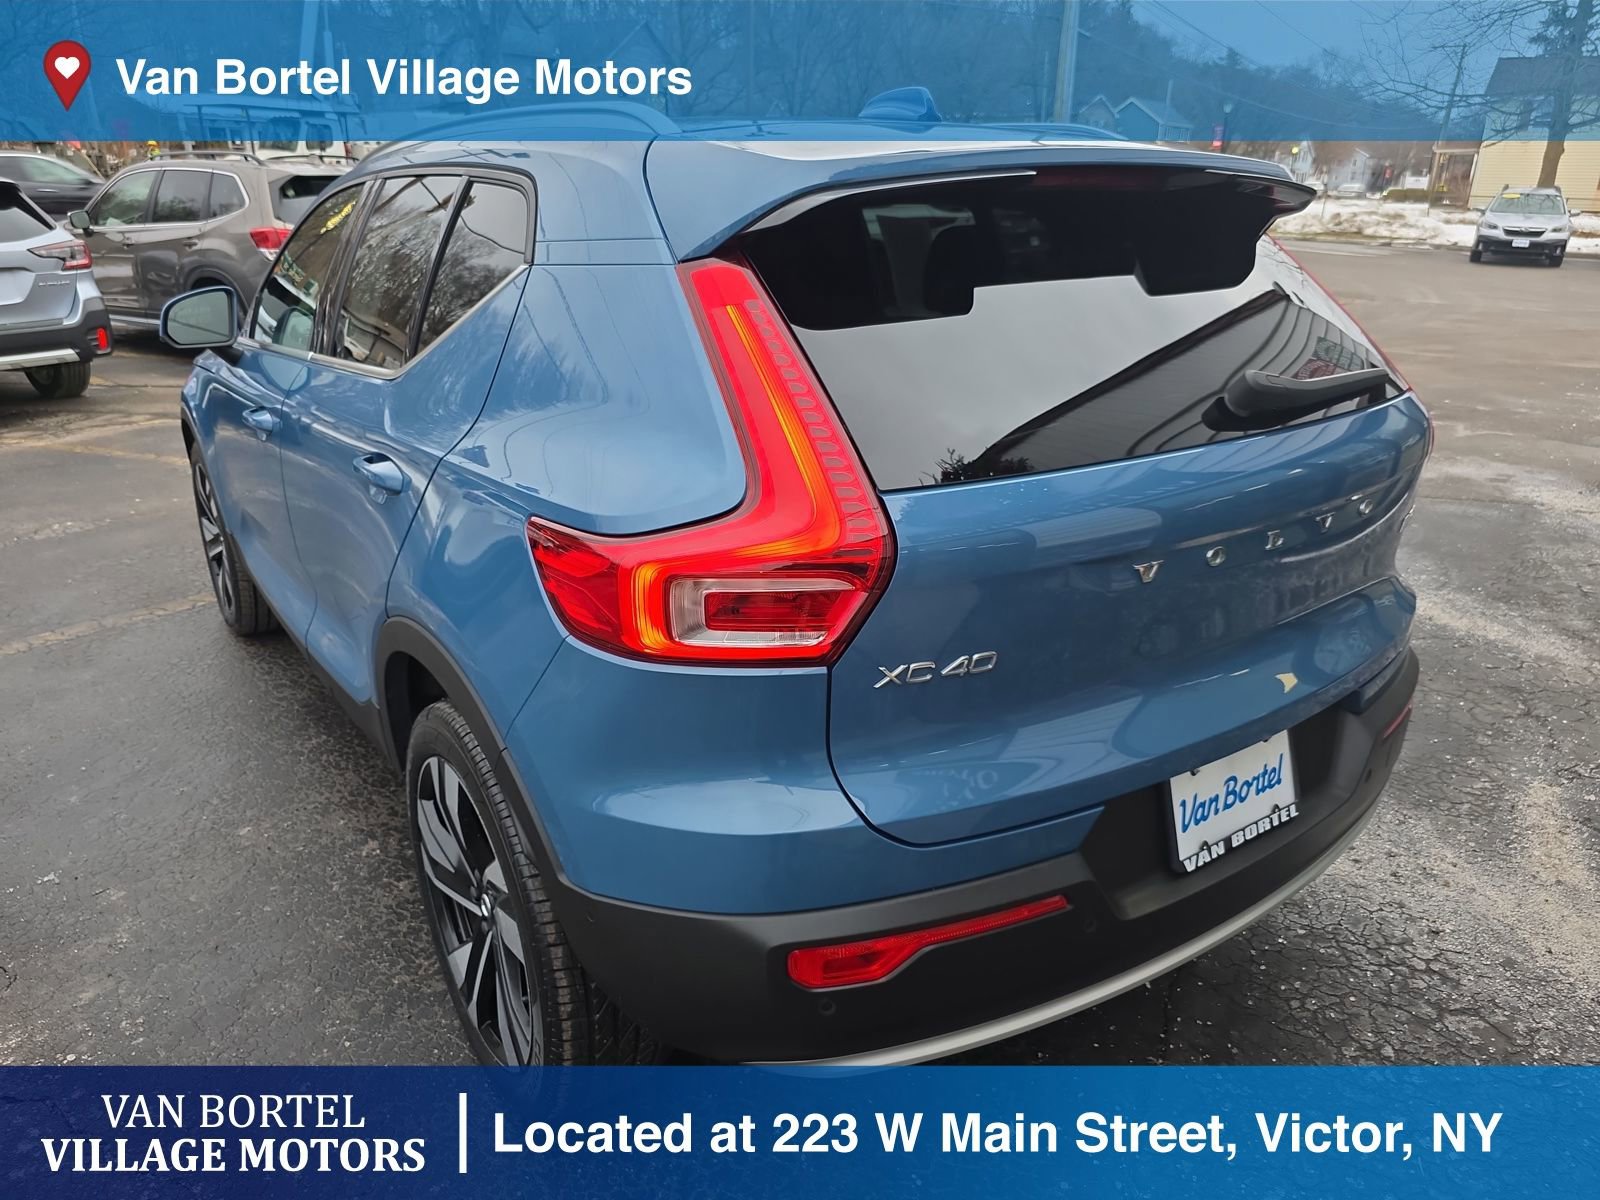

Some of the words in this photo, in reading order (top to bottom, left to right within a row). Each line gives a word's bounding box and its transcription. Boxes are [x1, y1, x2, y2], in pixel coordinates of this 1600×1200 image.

[1133, 499, 1373, 583] VOLVO
[1179, 793, 1219, 833] Van
[1221, 753, 1284, 812] Bortel
[1183, 842, 1225, 872] VAN
[1231, 804, 1299, 848] BORTEL
